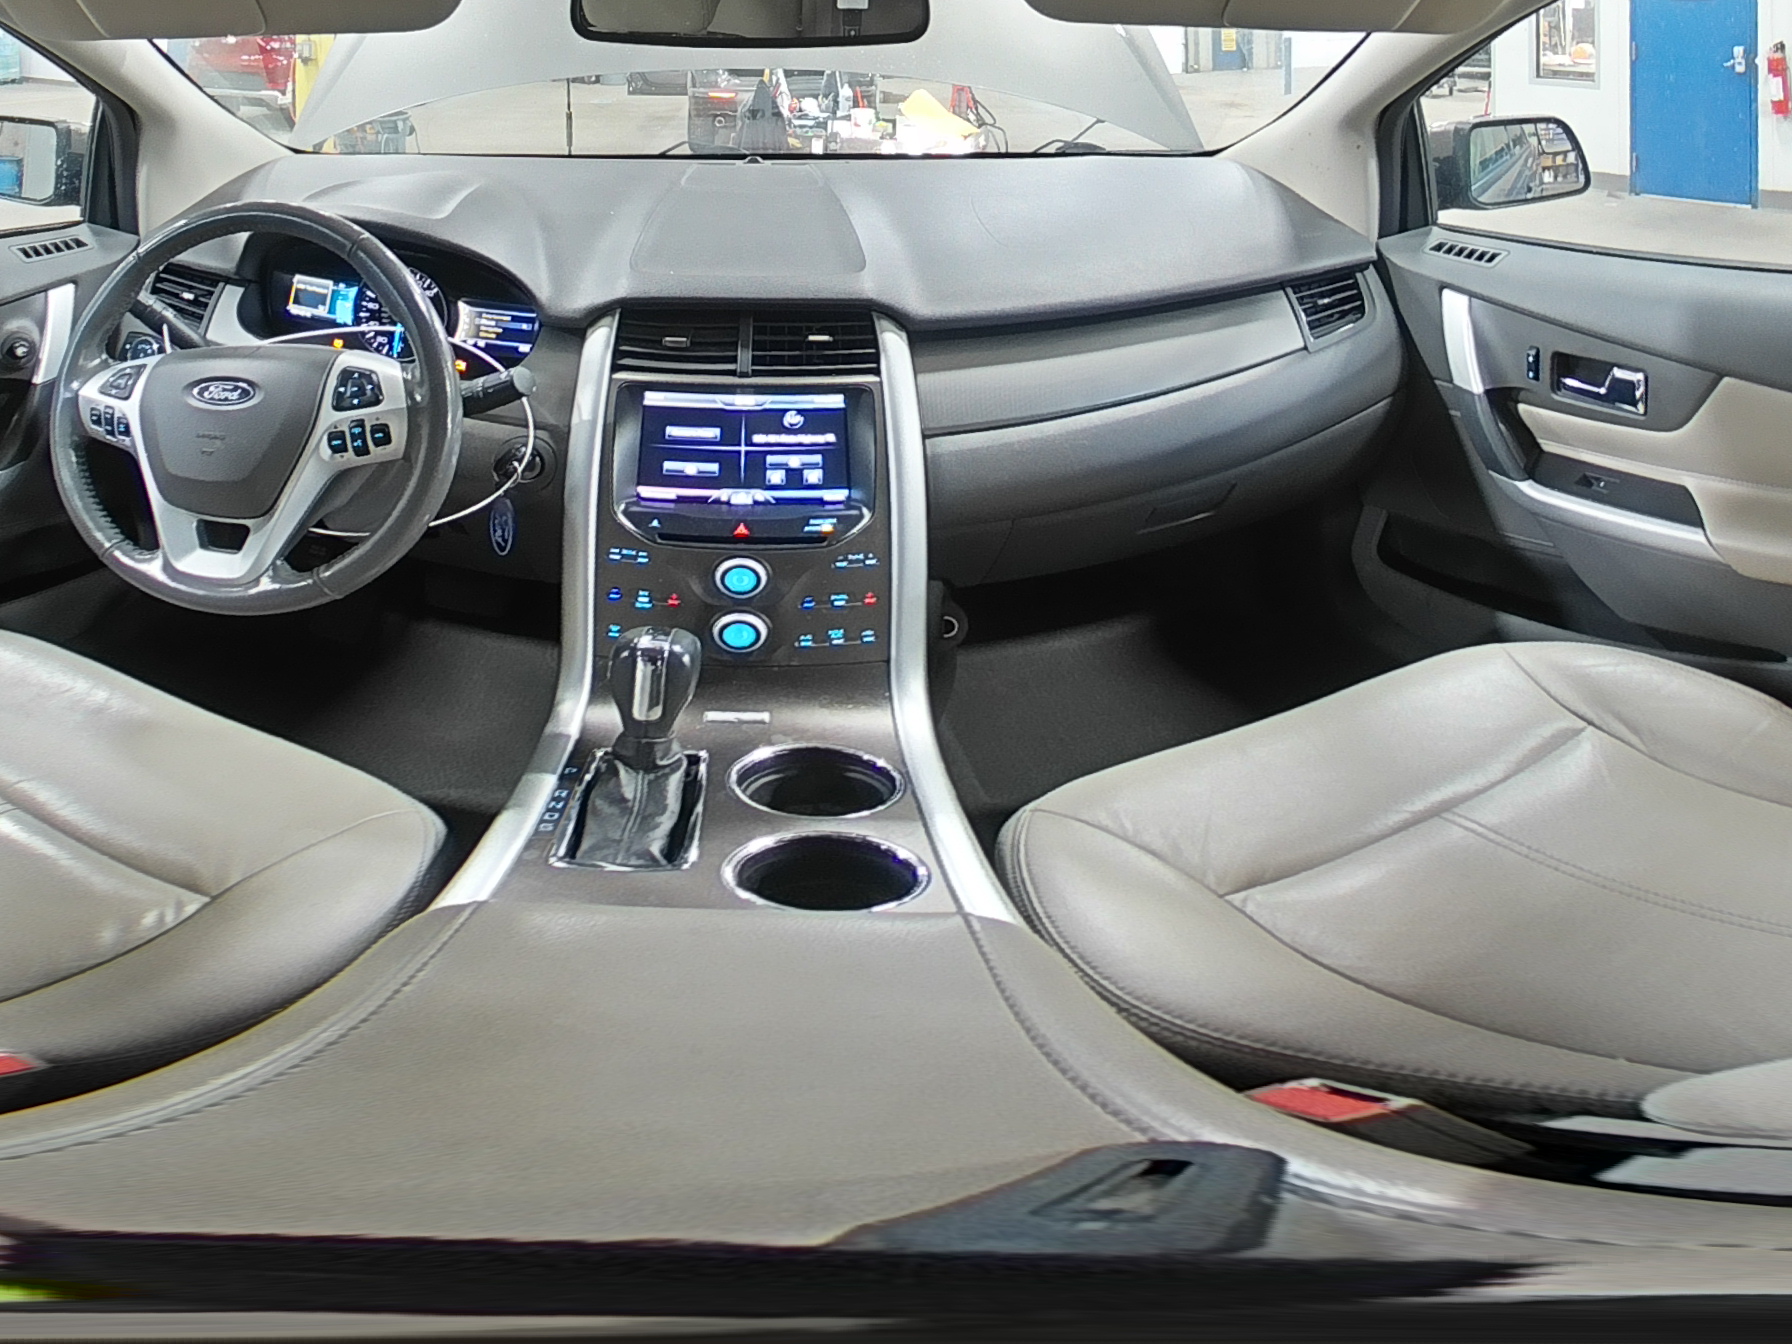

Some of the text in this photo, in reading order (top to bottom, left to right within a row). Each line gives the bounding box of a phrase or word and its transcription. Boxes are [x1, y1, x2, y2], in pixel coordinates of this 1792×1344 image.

[203, 384, 243, 400] Ford
[549, 801, 564, 809] N
[543, 812, 559, 820] D
